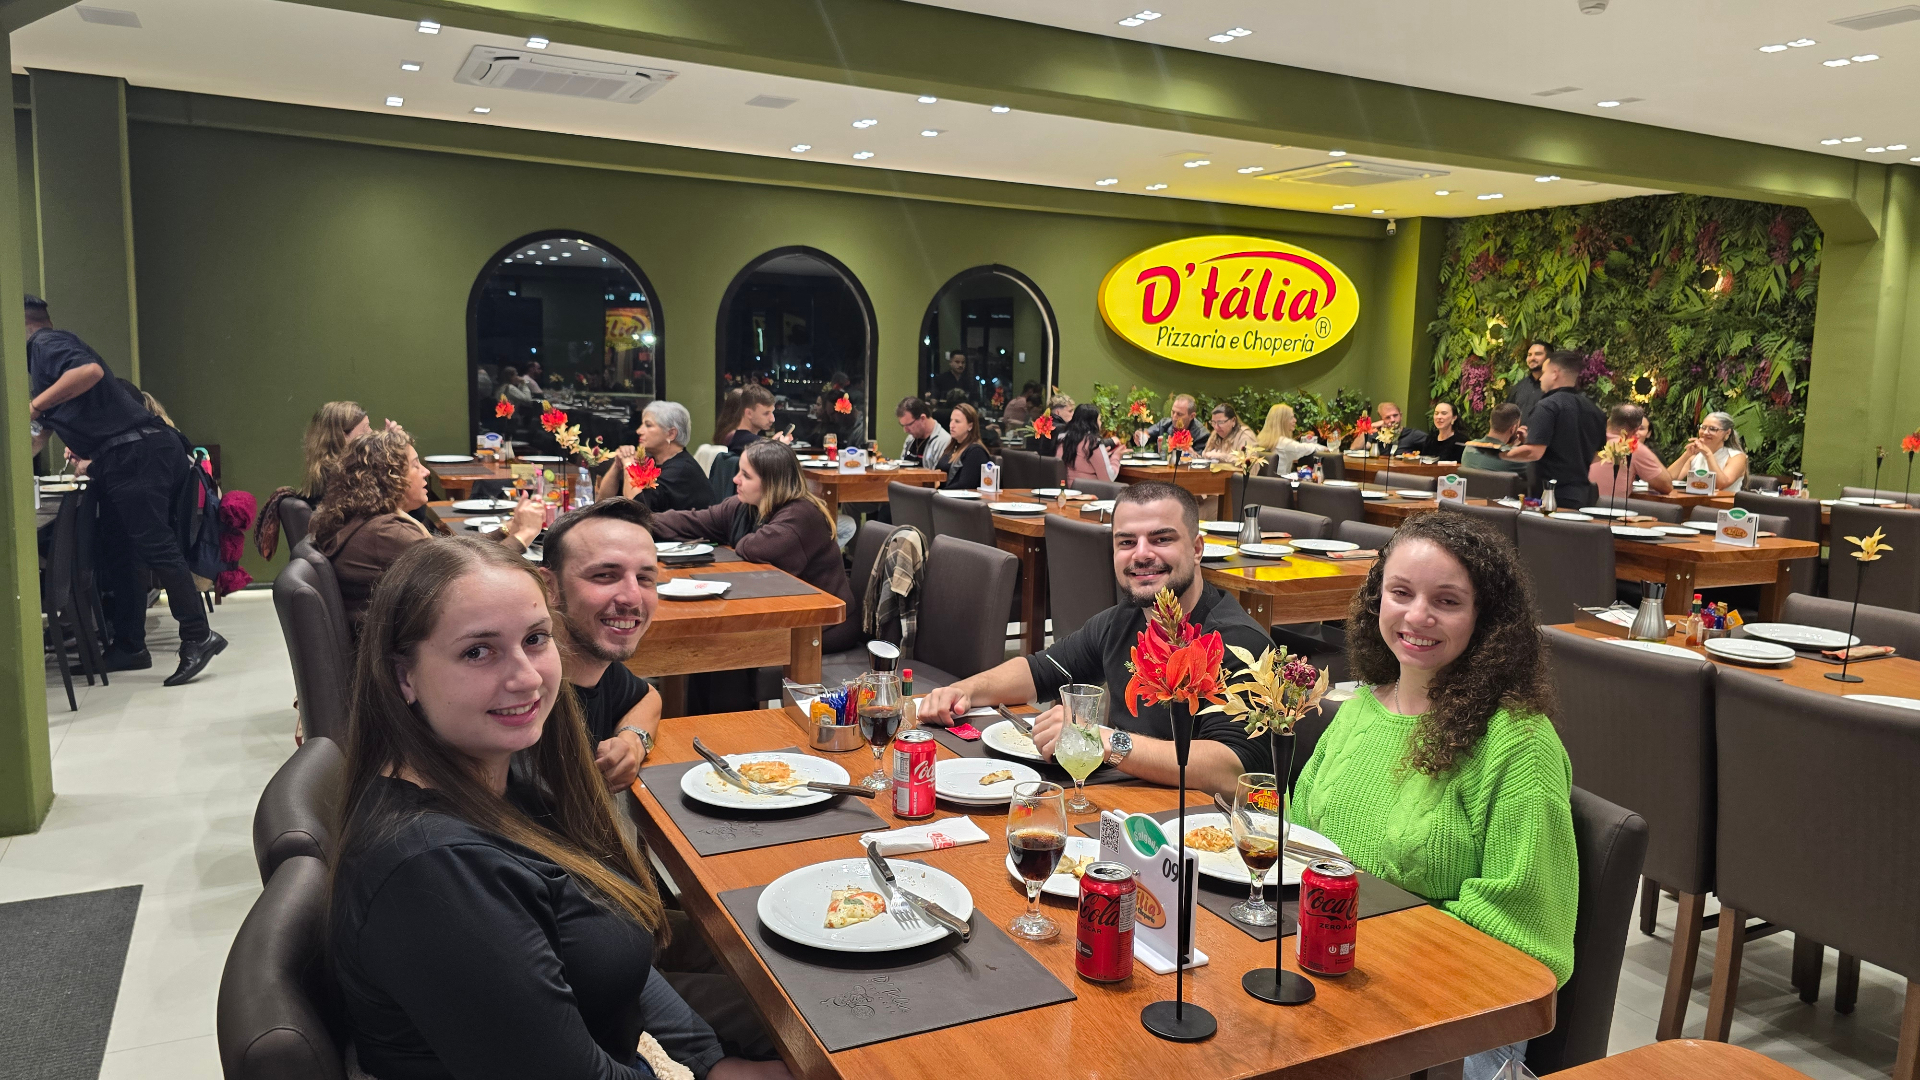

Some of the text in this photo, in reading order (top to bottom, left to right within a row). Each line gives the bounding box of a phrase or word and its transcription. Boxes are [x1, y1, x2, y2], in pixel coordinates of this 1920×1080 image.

[1157, 325, 1315, 357] Pizzaria e Choperia
[1162, 857, 1178, 882] 09
[1306, 888, 1348, 915] Coca
[1319, 922, 1341, 931] ZERO
